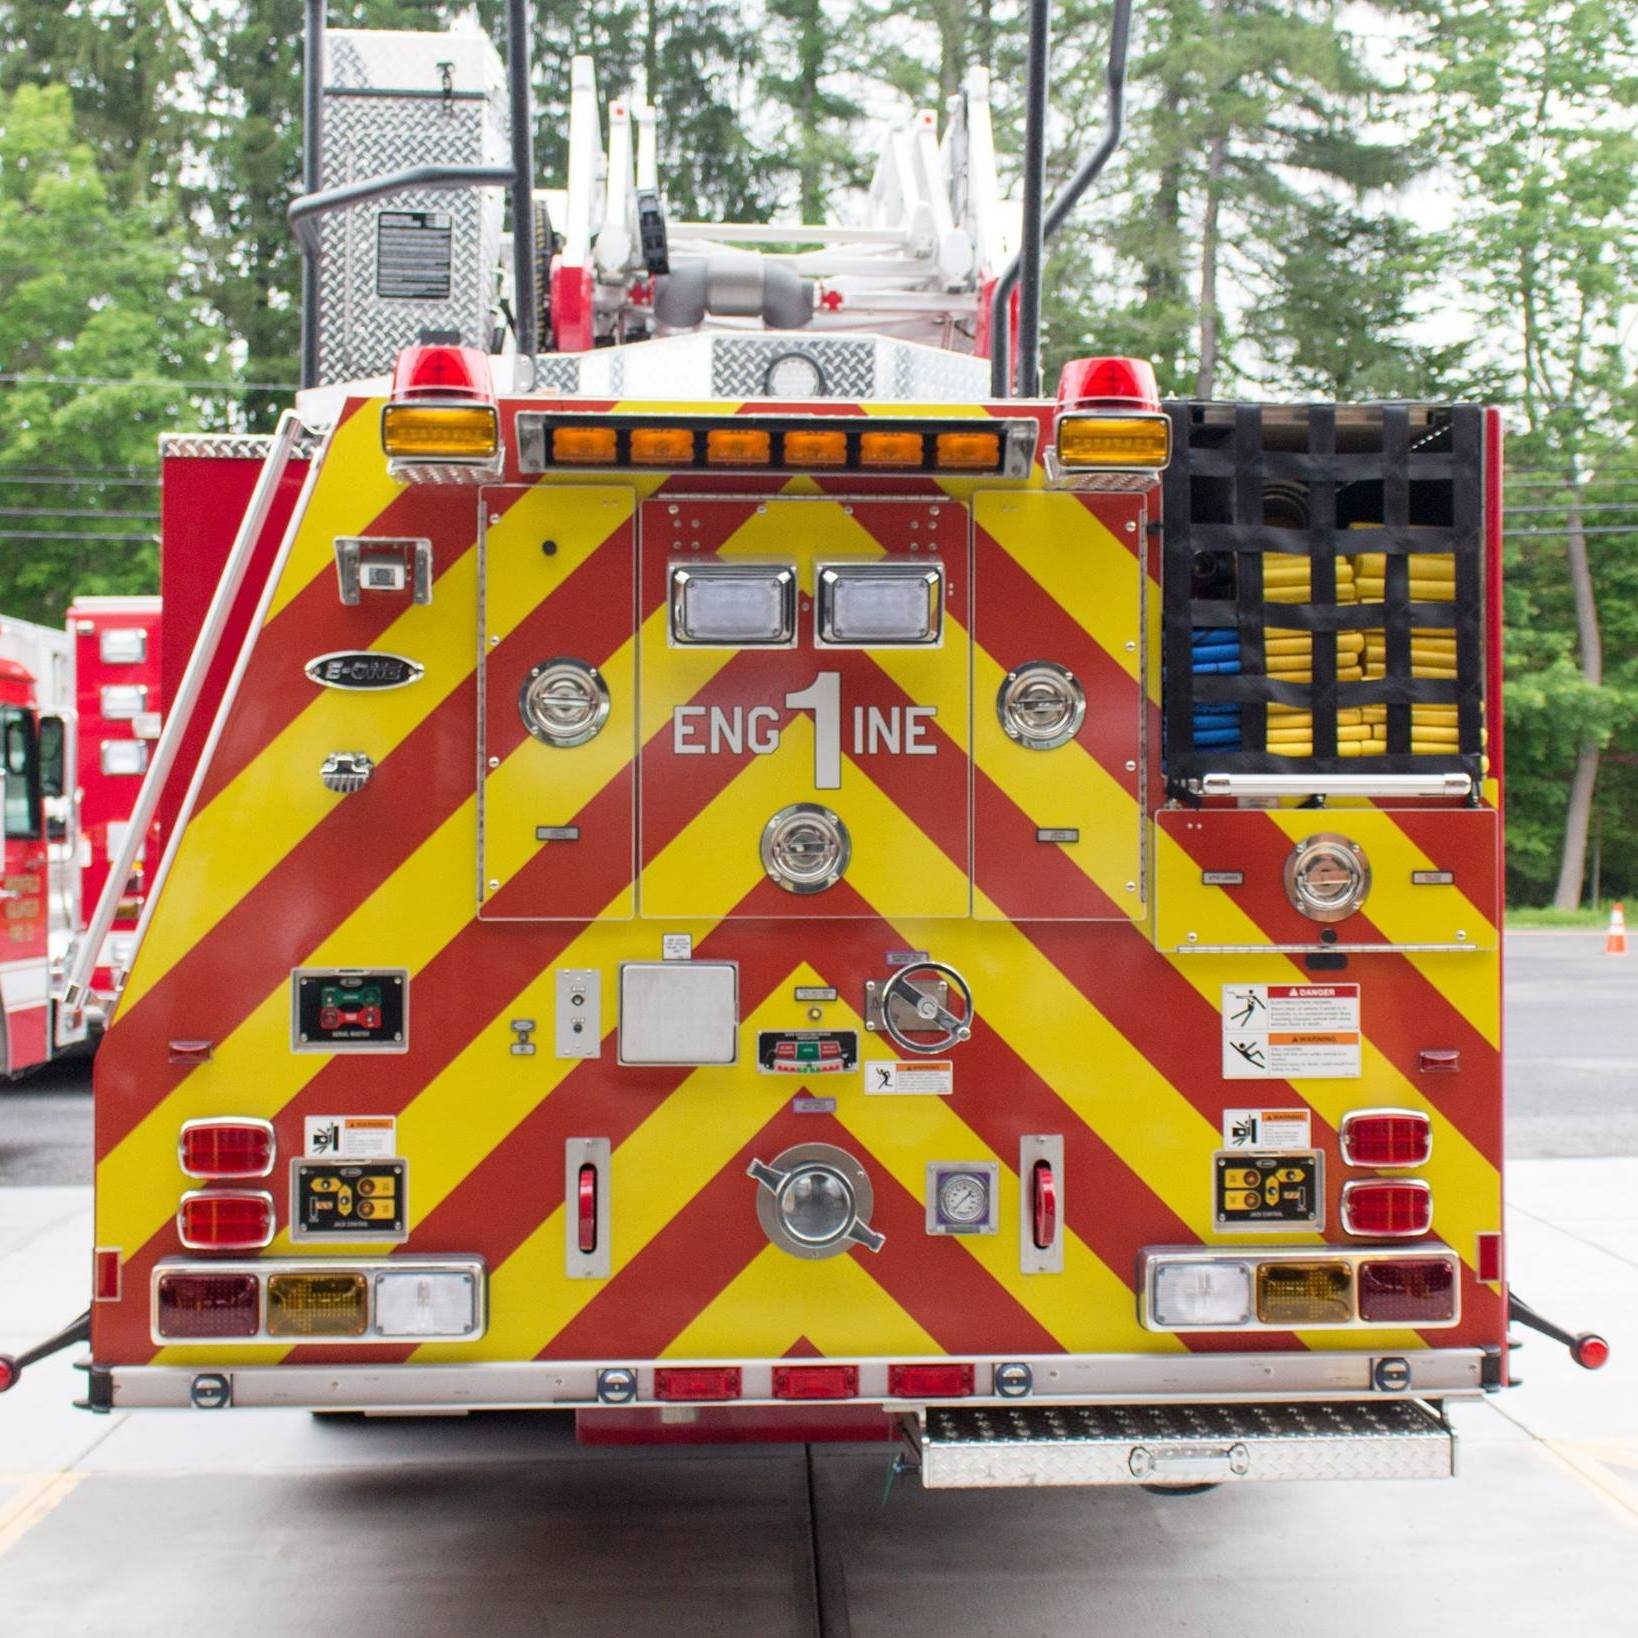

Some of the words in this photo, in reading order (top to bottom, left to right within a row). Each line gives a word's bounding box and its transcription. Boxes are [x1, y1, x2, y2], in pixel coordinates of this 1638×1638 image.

[673, 705, 780, 755] ENG
[785, 671, 841, 790] 1
[853, 705, 938, 755] INE
[1299, 988, 1336, 997] DANGER
